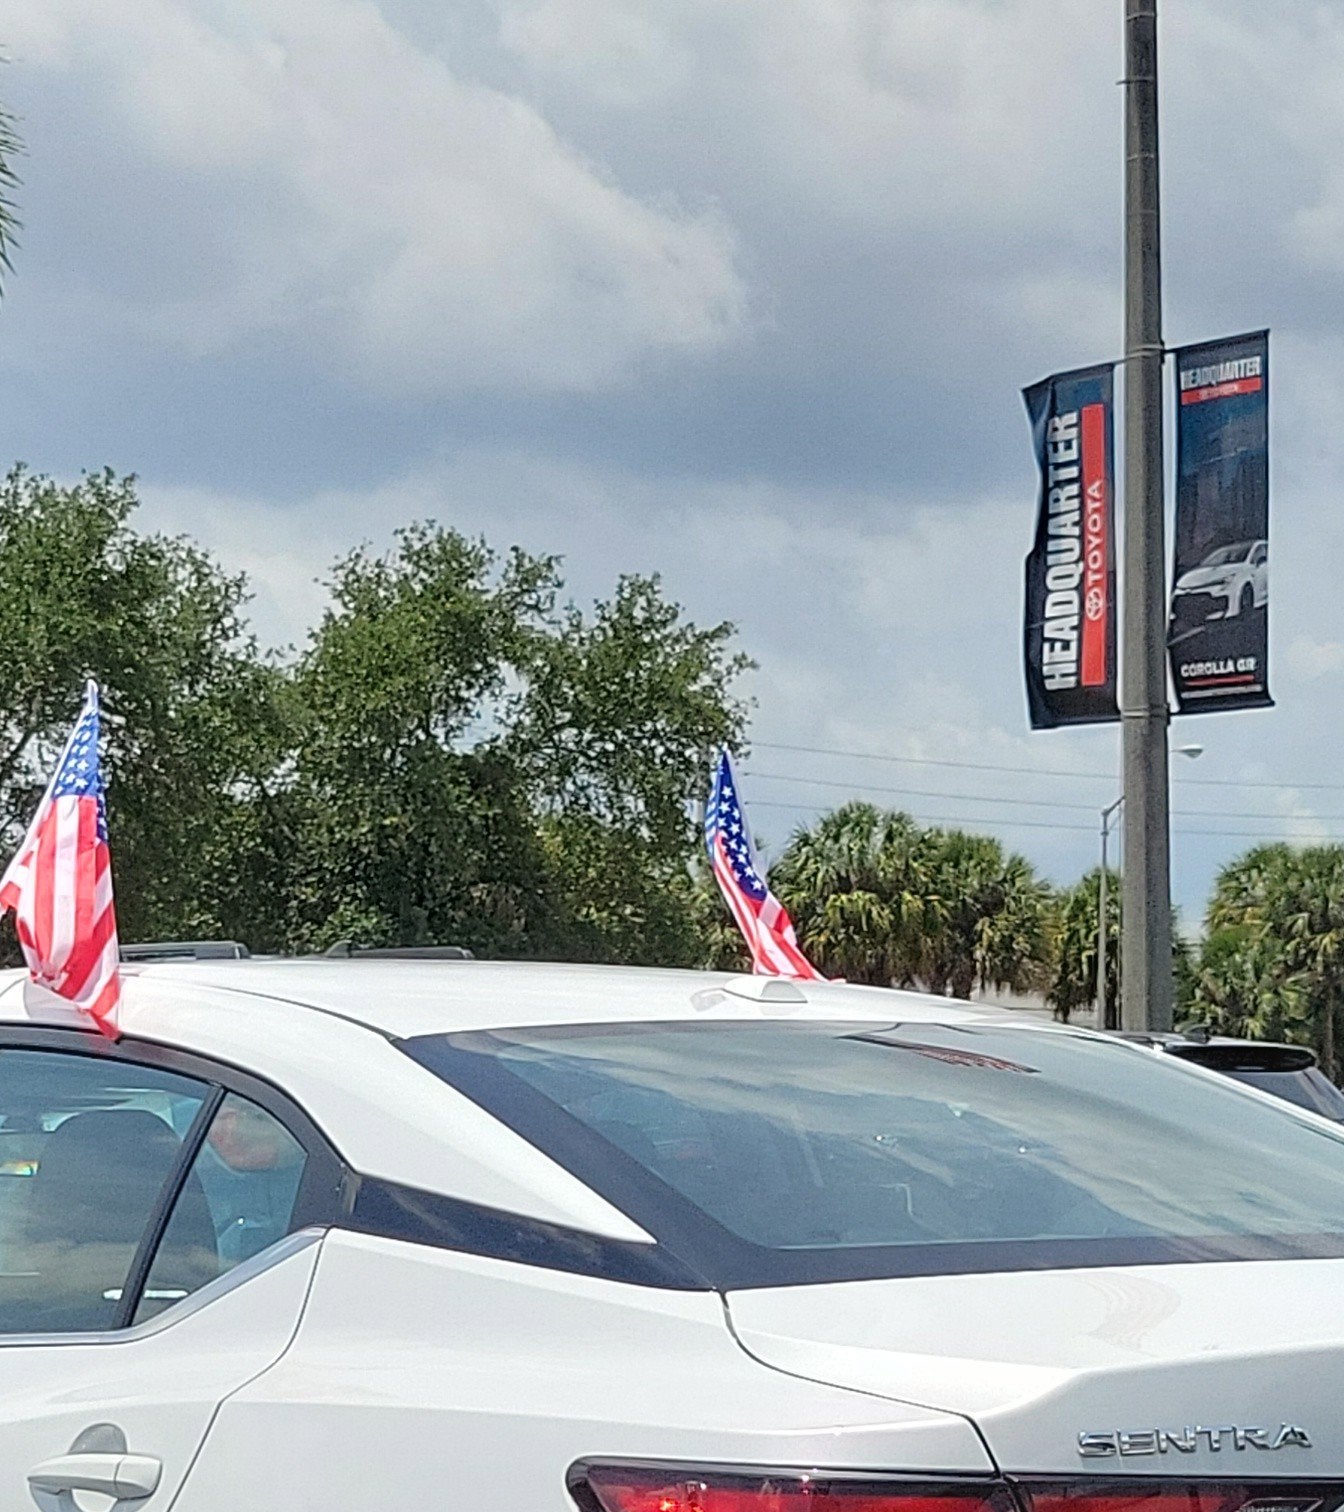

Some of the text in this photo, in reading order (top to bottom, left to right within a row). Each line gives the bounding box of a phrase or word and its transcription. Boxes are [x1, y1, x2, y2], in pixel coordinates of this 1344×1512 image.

[1042, 411, 1084, 690] HEADQUARTER
[1087, 480, 1103, 587] TOYOTA
[1180, 659, 1235, 677] COROLLA
[1077, 1422, 1314, 1457] SENTRA
